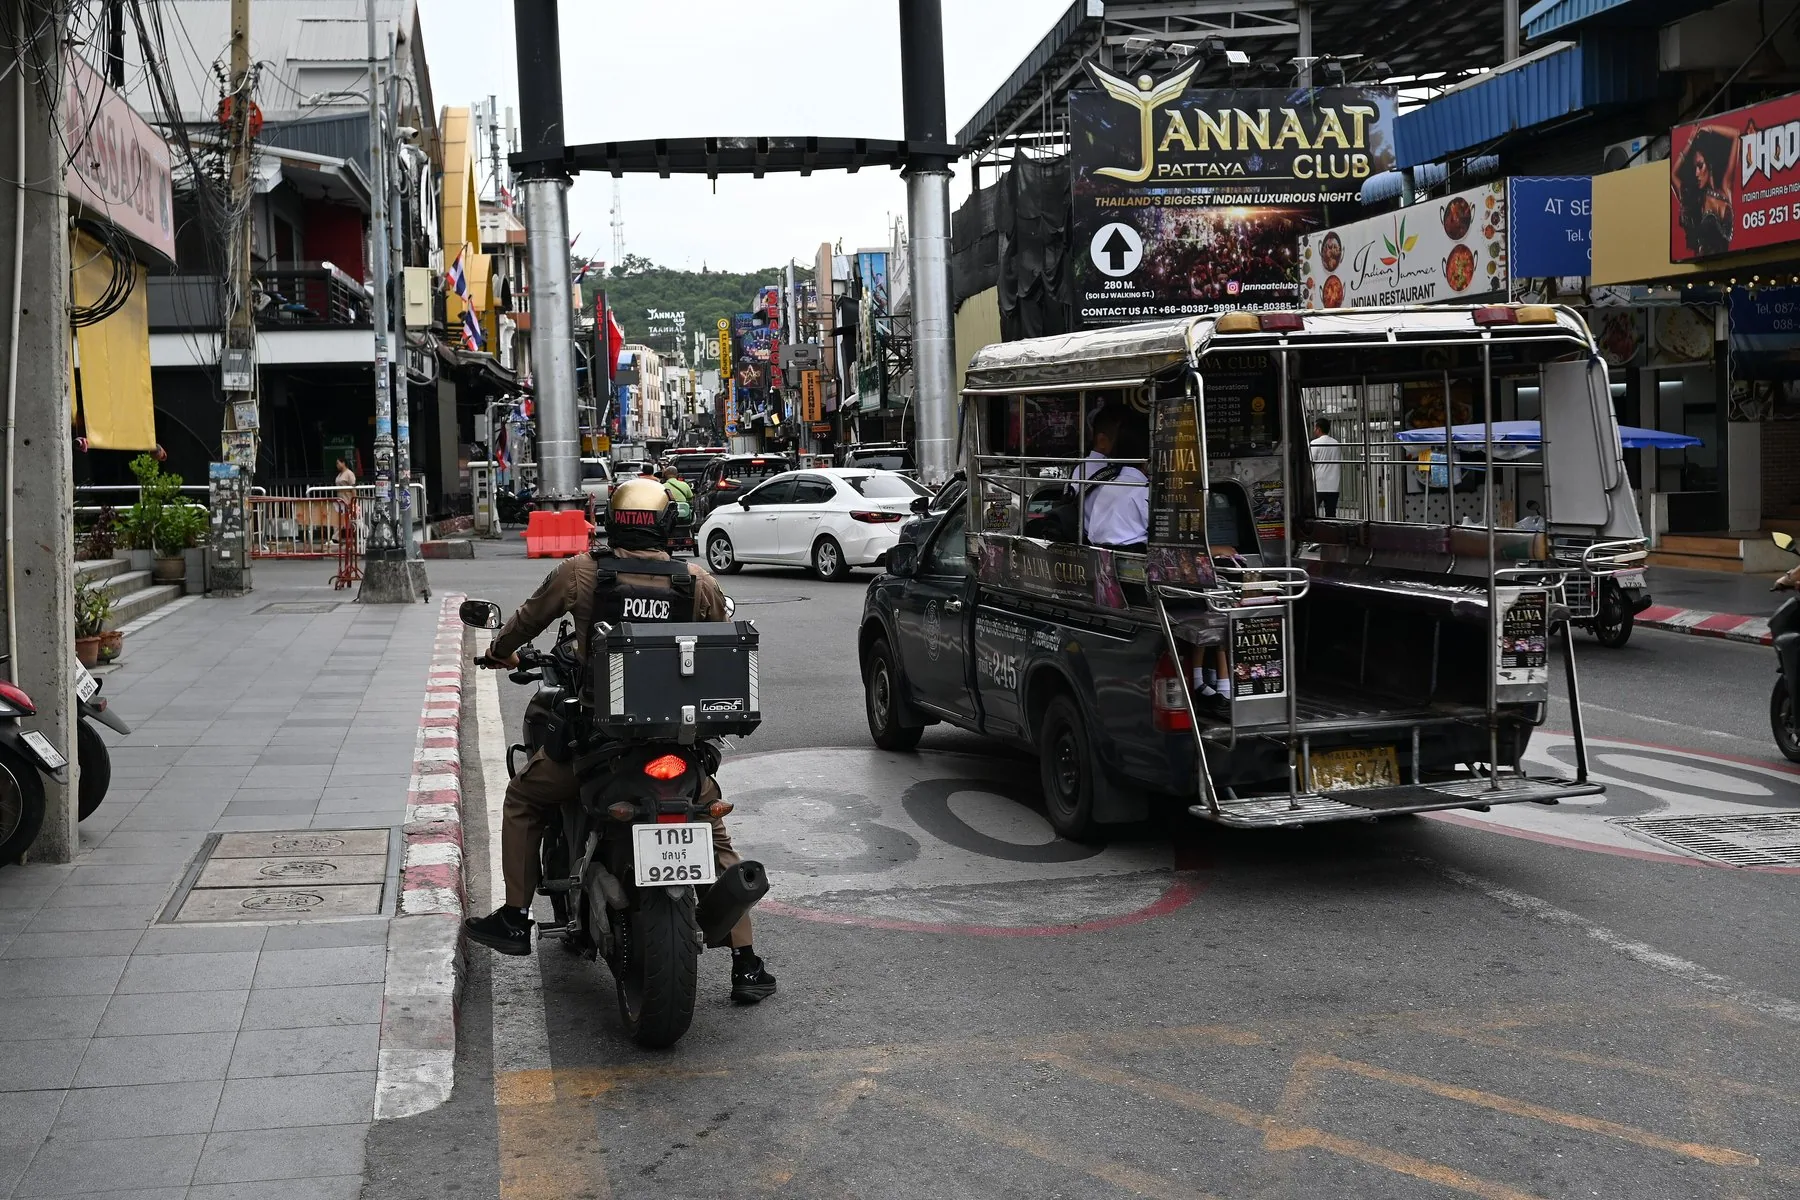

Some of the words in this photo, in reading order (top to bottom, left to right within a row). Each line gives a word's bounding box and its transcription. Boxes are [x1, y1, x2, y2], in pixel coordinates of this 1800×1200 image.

[1088, 60, 1375, 183] JANNAAT
[1157, 162, 1246, 177] PATTAYA
[1293, 154, 1371, 179] CLUB
[1095, 197, 1161, 207] THAILAND'S
[1163, 195, 1211, 205] BIGGEST
[1212, 194, 1254, 204] INDIAN
[1254, 193, 1316, 204] LUXURIOUS
[1318, 192, 1353, 203] NIGHT
[1544, 198, 1564, 215] AT
[1570, 199, 1592, 216] SE
[1743, 210, 1766, 229] 065
[1769, 205, 1788, 224] 251
[1565, 229, 1584, 242] Tel.
[1351, 240, 1392, 290] Indian
[1389, 251, 1437, 288] Summer
[1104, 281, 1122, 289] 280
[1123, 281, 1136, 289] M.
[1379, 282, 1436, 306] RESTAURANT
[647, 308, 686, 320] JANNAAT
[1081, 307, 1127, 317] CONTACT
[1128, 306, 1140, 316] US
[1142, 305, 1157, 315] AT:
[1241, 302, 1299, 311] +66-80385-
[1206, 382, 1250, 392] Reservations
[807, 371, 815, 421] EXCHANGE
[1157, 448, 1197, 473] JALWA
[1164, 477, 1184, 489] CLUB
[615, 510, 656, 525] PATTAYA
[1022, 555, 1052, 581] JALWA
[1054, 561, 1088, 586] CLUB
[623, 598, 670, 619] POLICE
[1507, 609, 1543, 621] ALWA
[1236, 633, 1280, 648] JALWA
[1246, 647, 1268, 655] CLUB
[80, 680, 96, 698] 8251
[655, 828, 694, 845] 1กย
[662, 848, 687, 862] ชลบุรี
[648, 865, 702, 882] 9265
